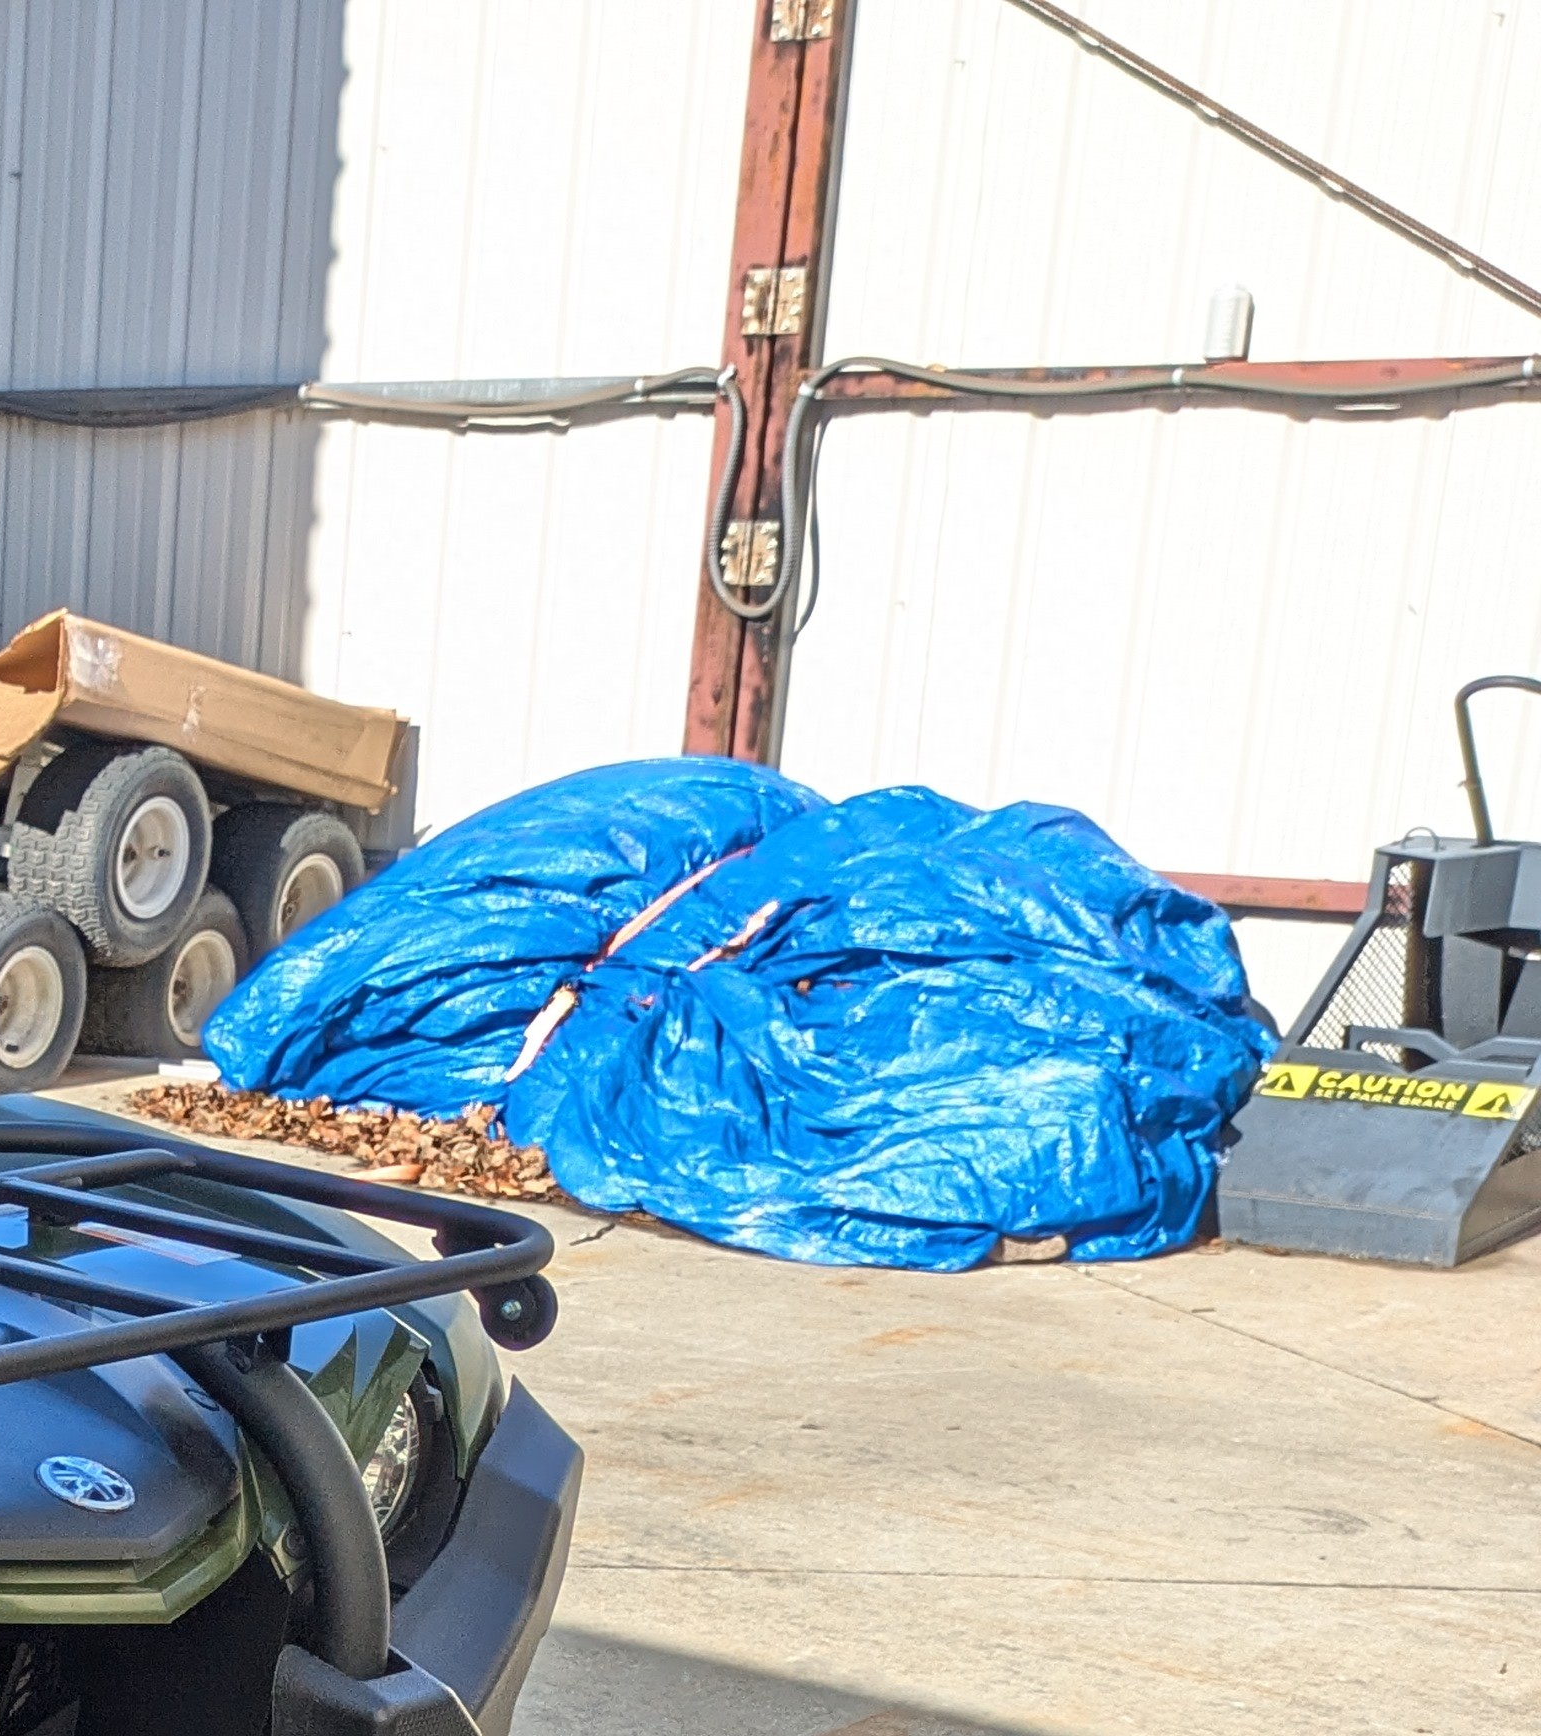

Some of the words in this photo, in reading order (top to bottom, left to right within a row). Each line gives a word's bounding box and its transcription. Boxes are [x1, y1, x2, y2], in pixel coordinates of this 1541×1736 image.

[1318, 1071, 1468, 1101] CAUTION
[1314, 1088, 1346, 1099] SET
[1349, 1092, 1395, 1105] PARK
[1398, 1096, 1458, 1111] BRAKE
